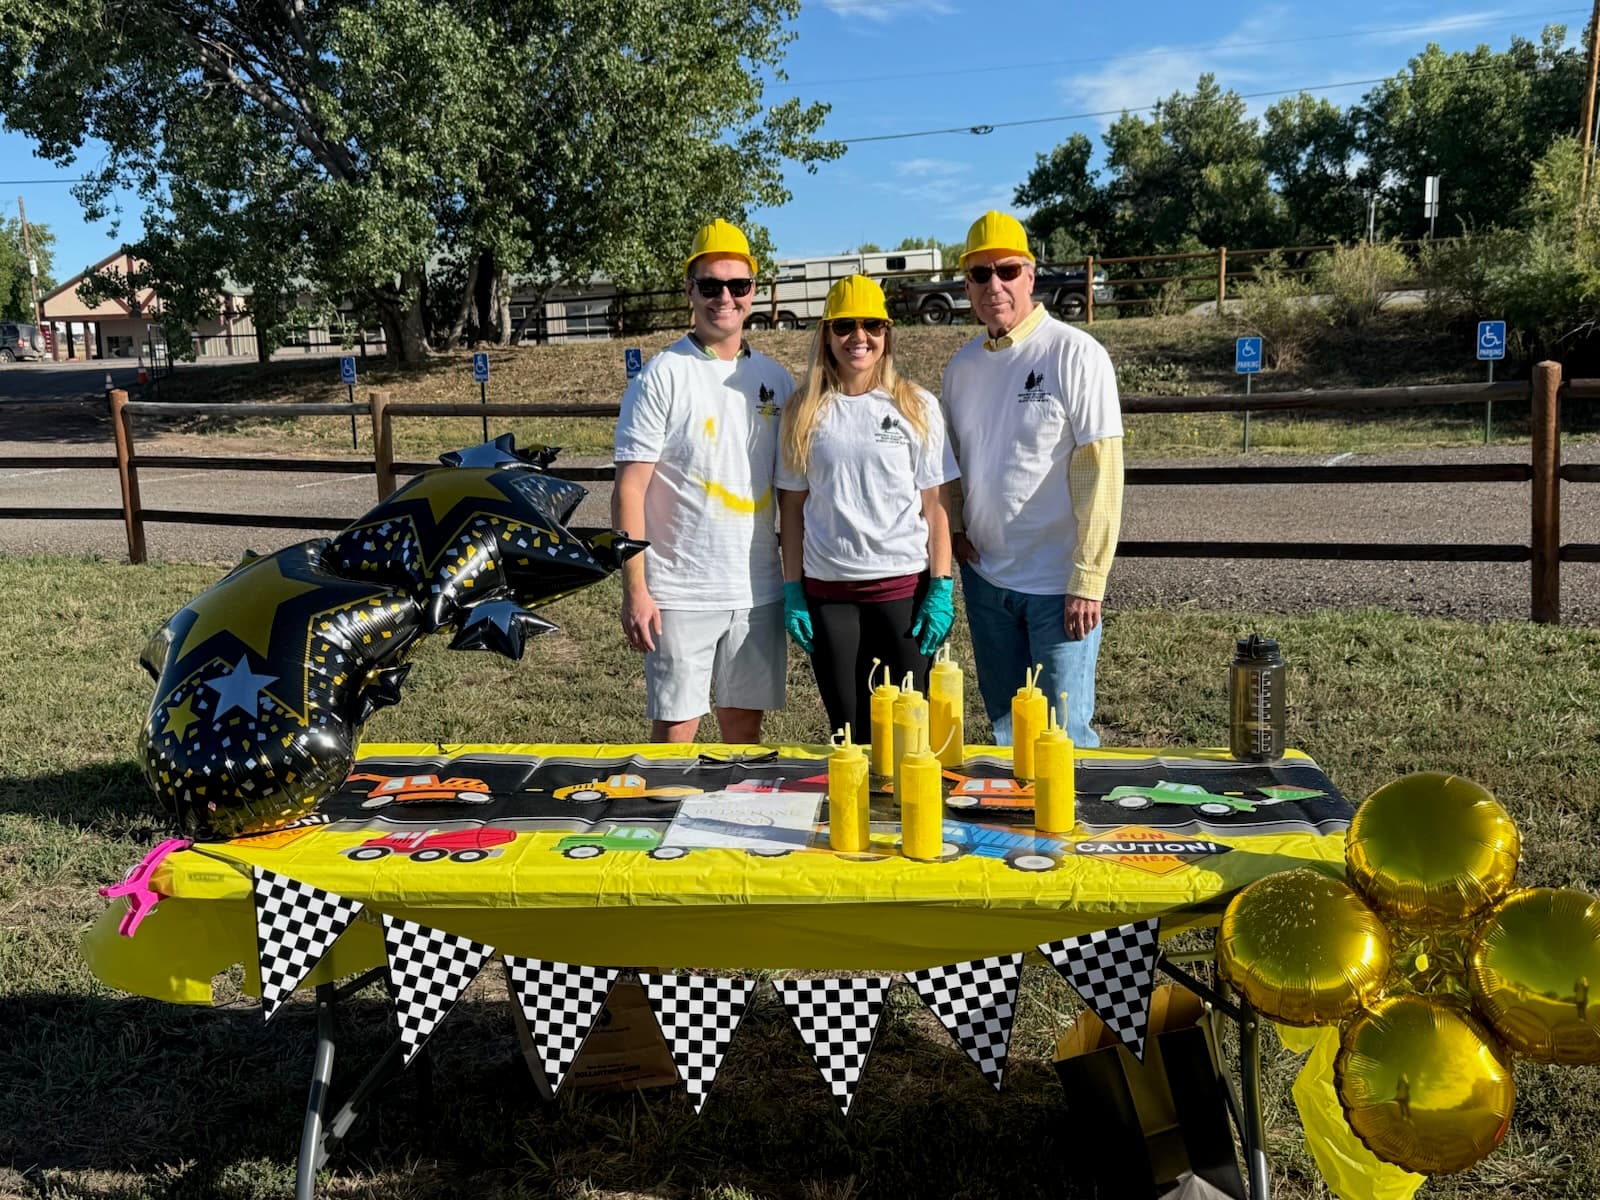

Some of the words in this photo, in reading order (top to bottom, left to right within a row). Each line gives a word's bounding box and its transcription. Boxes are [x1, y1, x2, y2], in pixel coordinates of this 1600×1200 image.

[1115, 832, 1166, 840] FUN
[1076, 842, 1217, 853] CAUTION!
[1119, 854, 1187, 863] AHEAD
